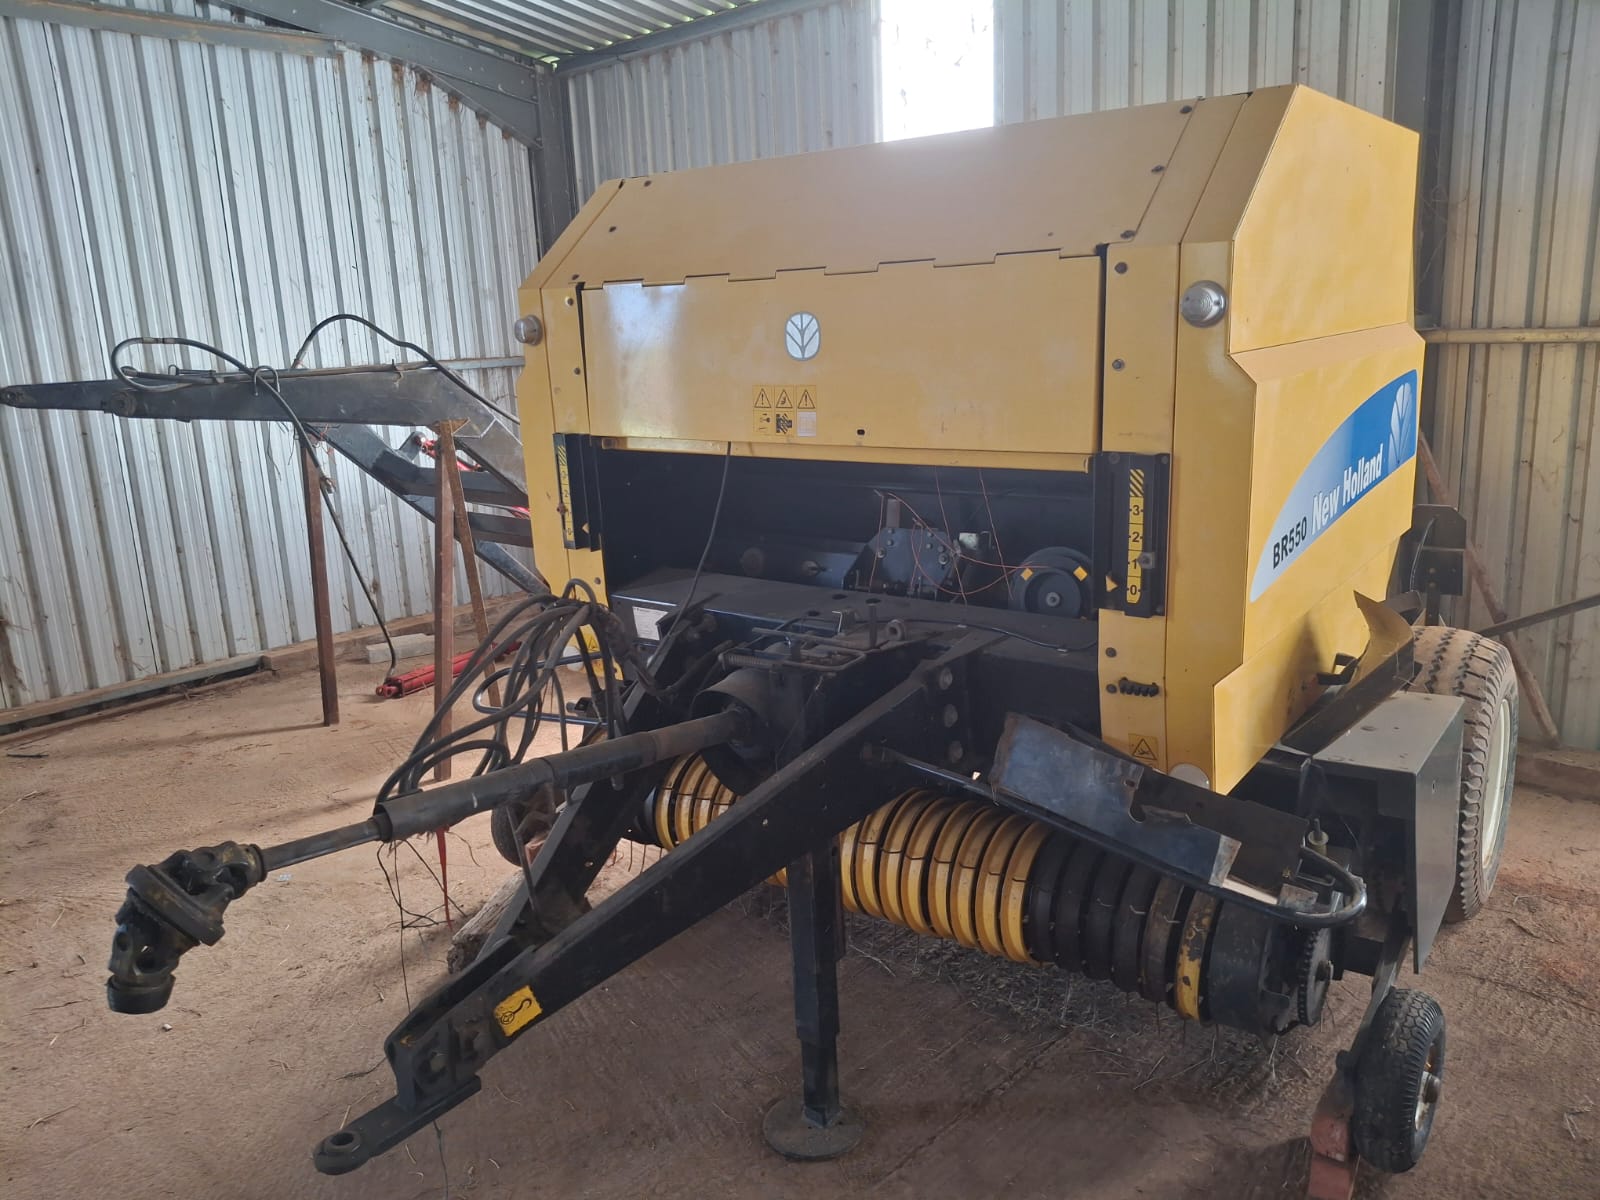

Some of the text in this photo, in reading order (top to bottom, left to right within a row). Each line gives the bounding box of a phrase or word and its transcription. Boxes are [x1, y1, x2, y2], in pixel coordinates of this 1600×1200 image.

[1132, 504, 1140, 516] 3
[1273, 443, 1384, 570] BR550 New Holland
[1131, 531, 1140, 543] 2
[1129, 584, 1138, 596] 0
